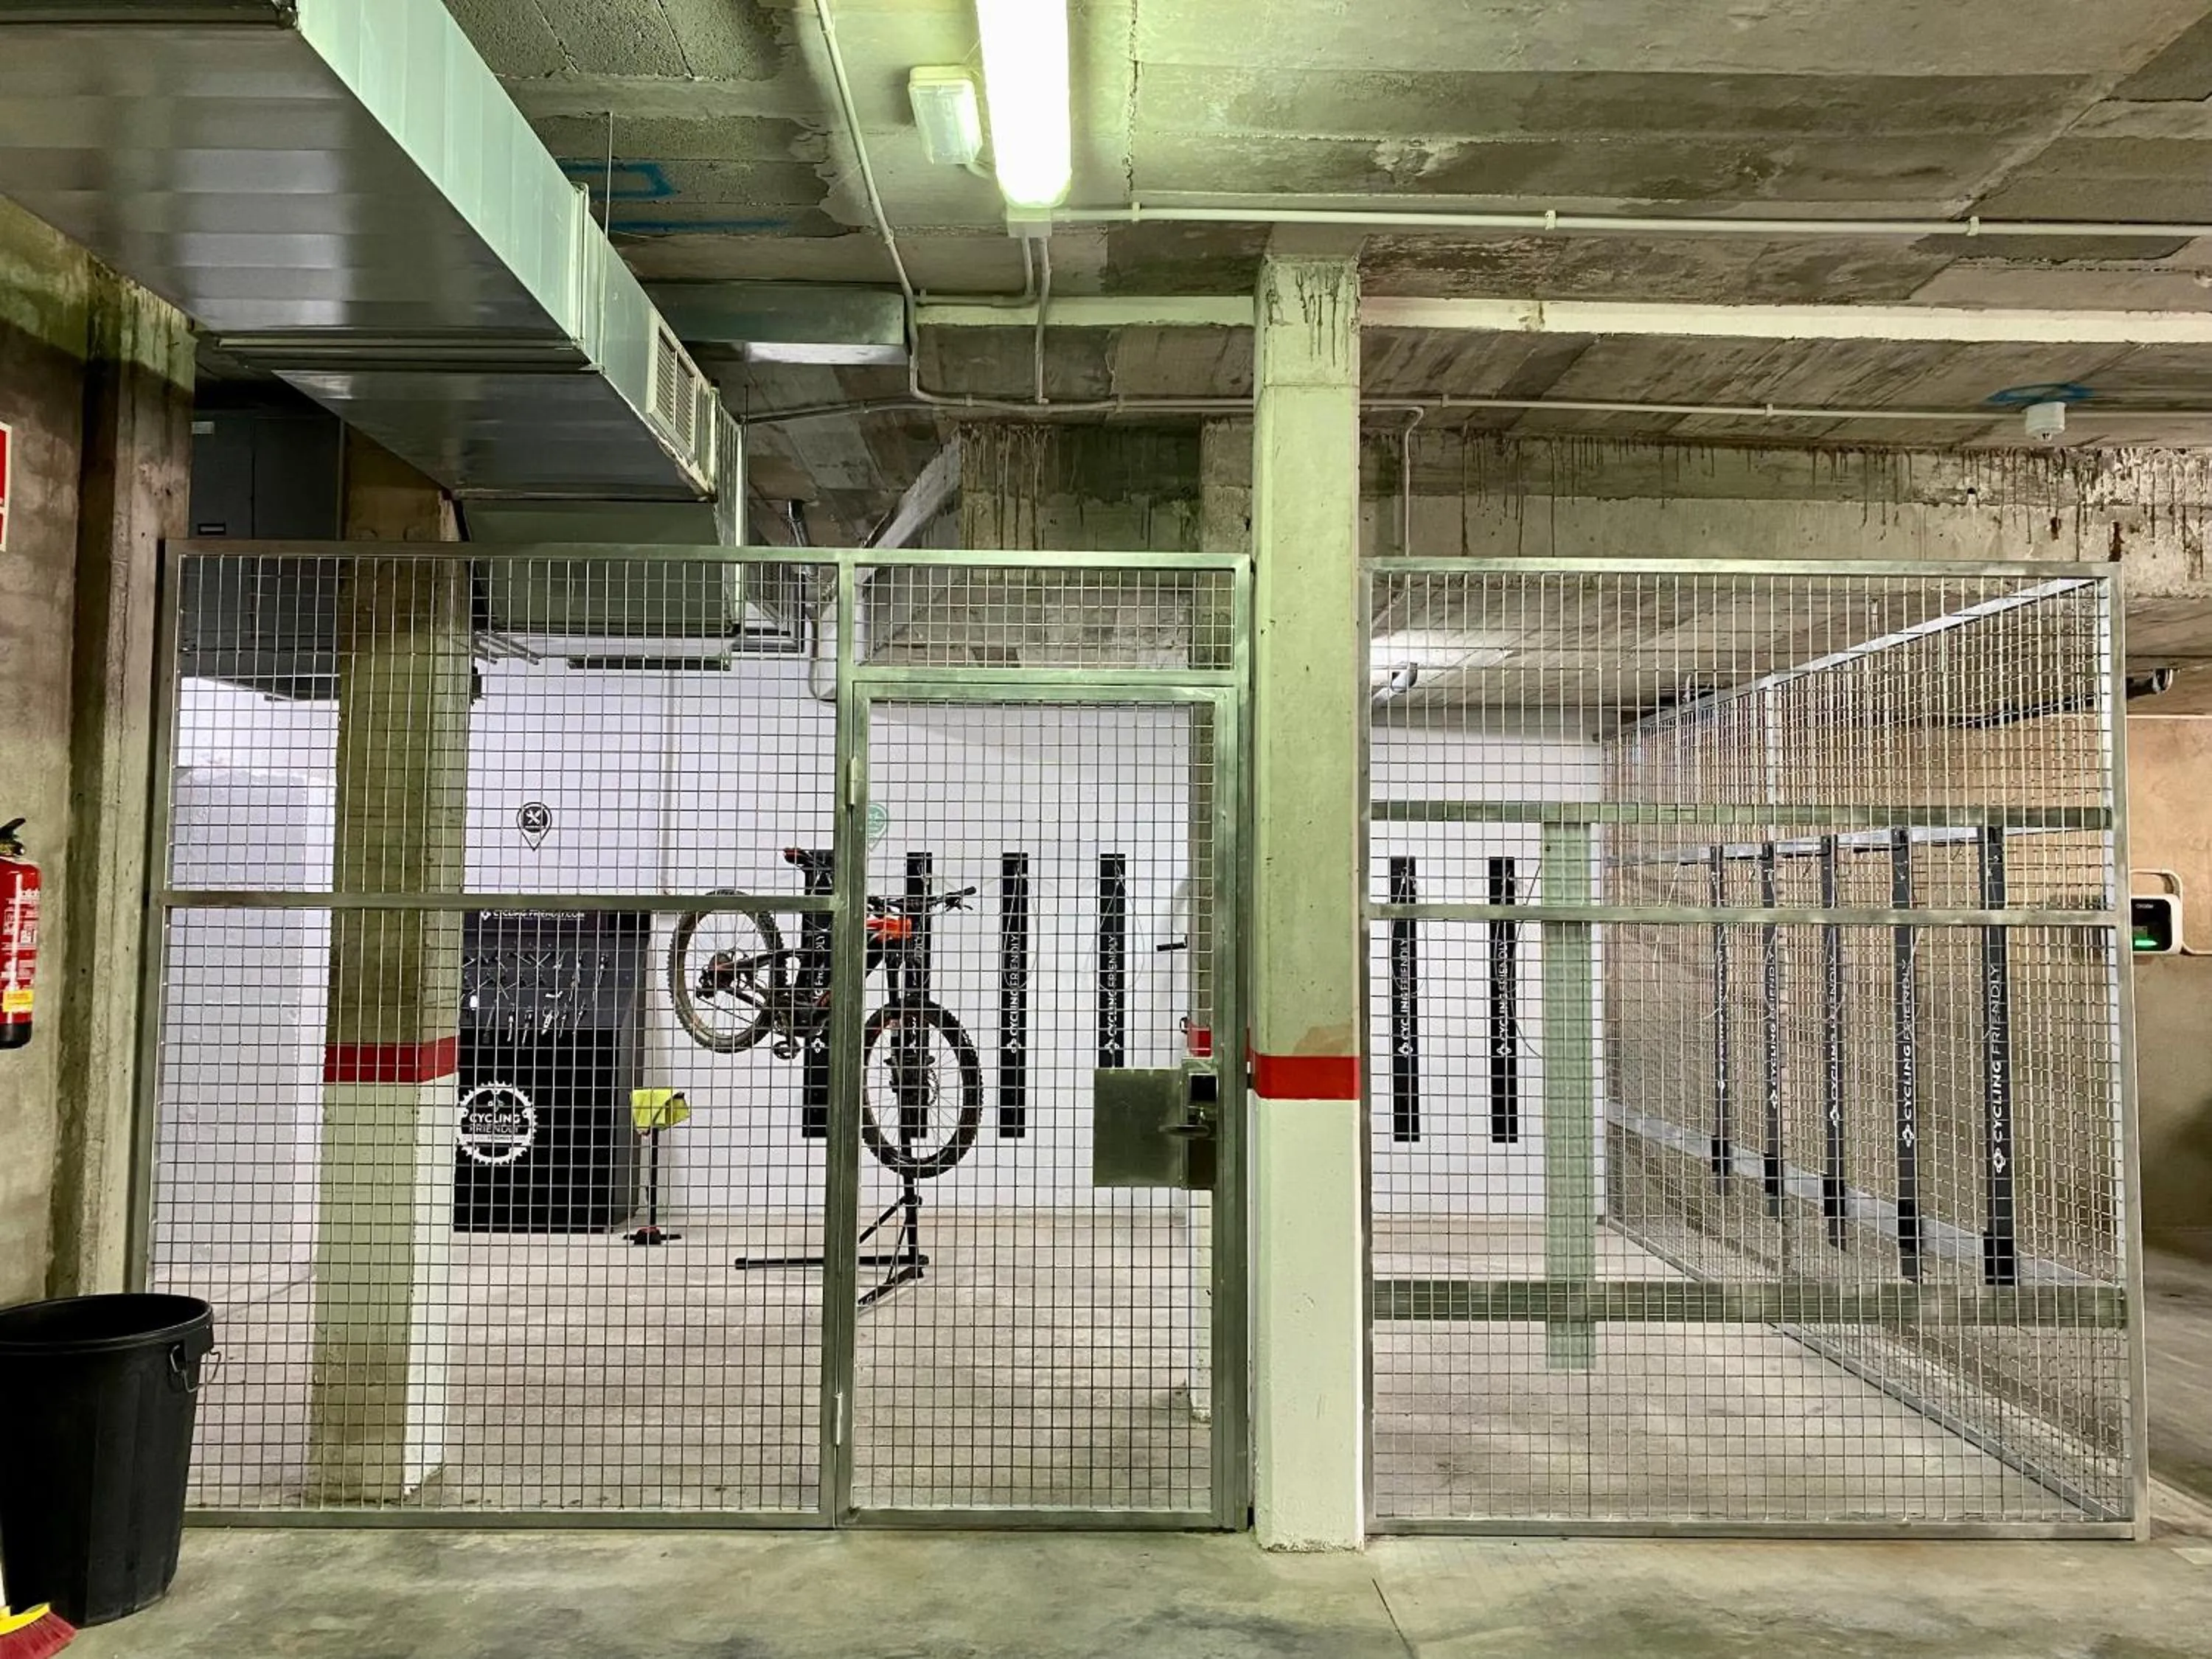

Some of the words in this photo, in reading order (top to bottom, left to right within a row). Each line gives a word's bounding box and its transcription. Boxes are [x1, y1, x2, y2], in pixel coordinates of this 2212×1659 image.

[1009, 934, 1020, 986] FRENDLY
[1107, 935, 1117, 987] FRENDLY
[1400, 992, 1410, 1040] CYCING
[1990, 964, 2002, 1055] FRIENDLY
[1903, 1046, 1912, 1120] CYCLING
[1992, 1061, 2003, 1143] CYCLING
[470, 1113, 521, 1123] CYCLING
